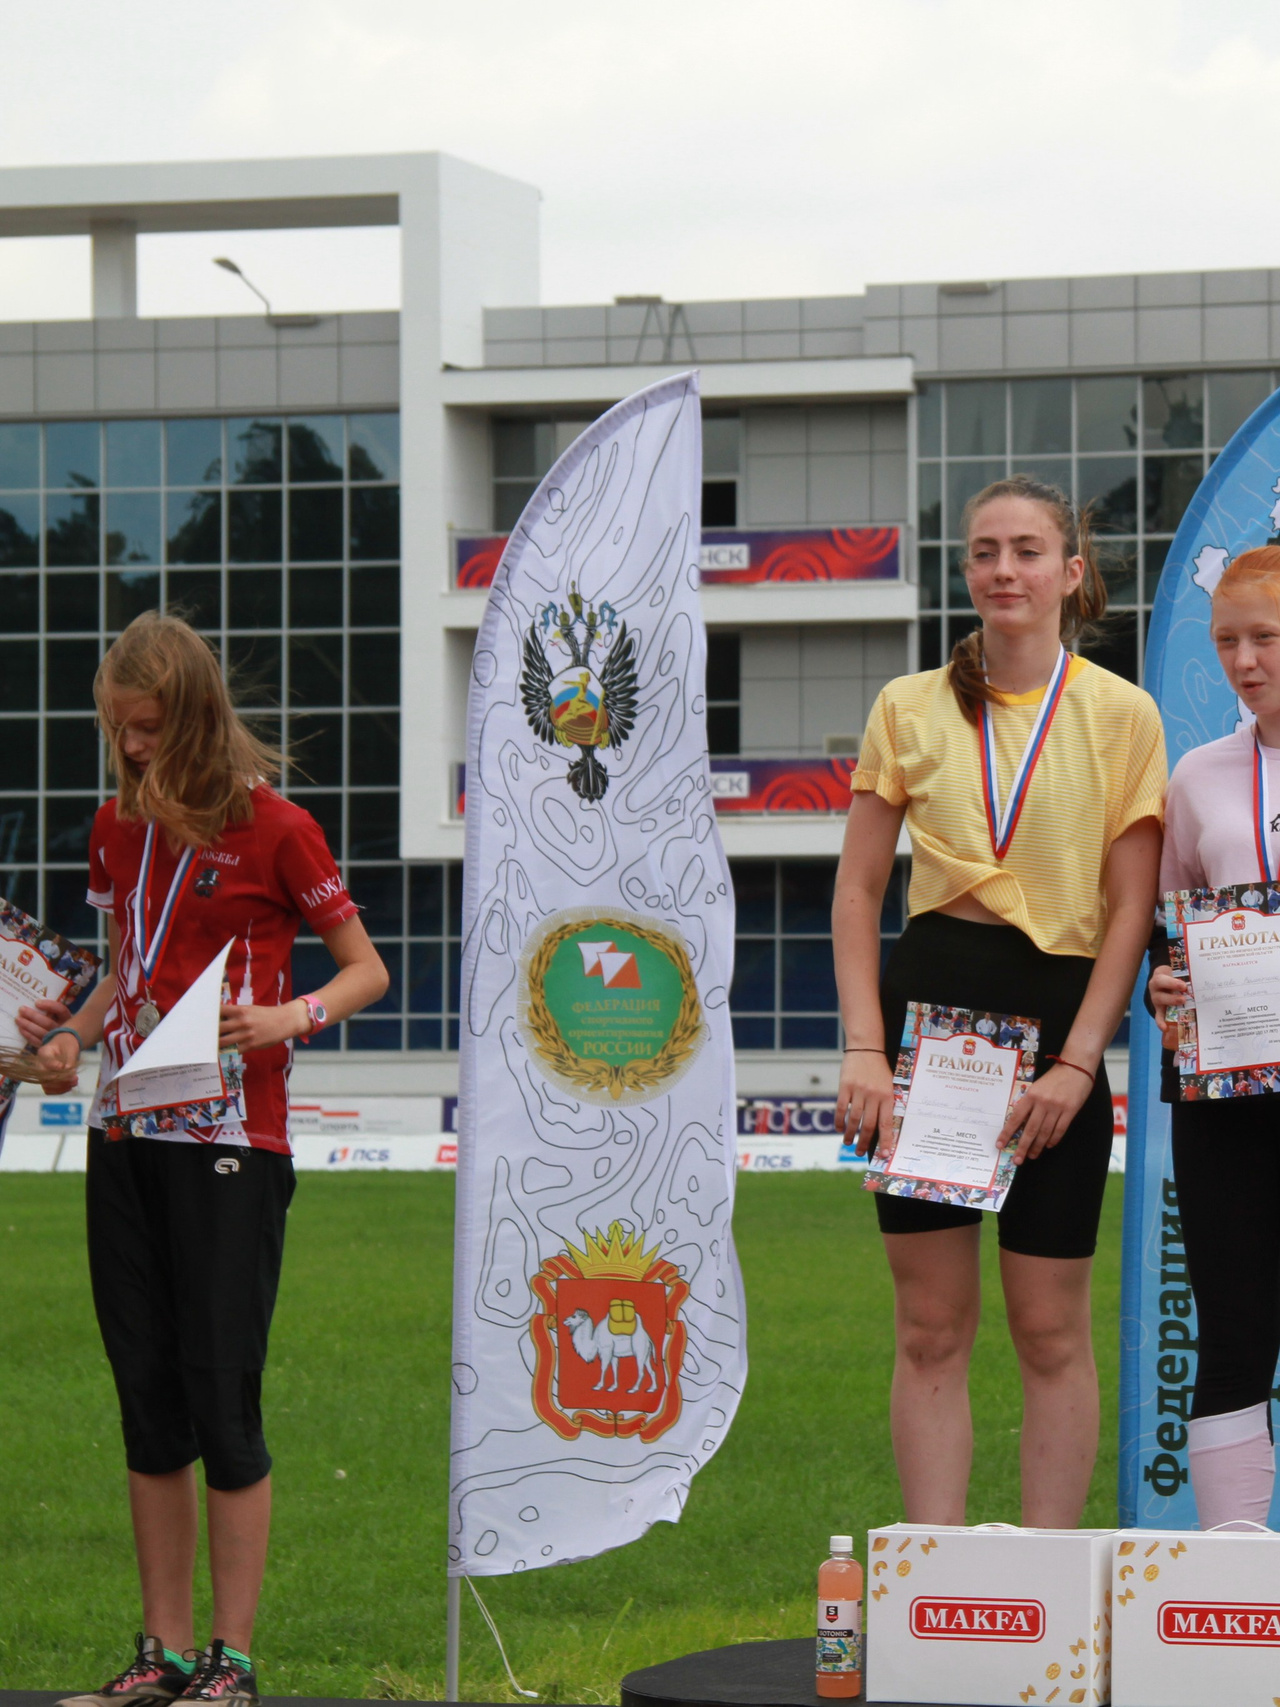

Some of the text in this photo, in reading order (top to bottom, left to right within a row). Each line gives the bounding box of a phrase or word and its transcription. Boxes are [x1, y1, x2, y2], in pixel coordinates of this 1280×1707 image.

[1198, 930, 1280, 951] ГРАМОТА
[0, 956, 49, 998] АМОТА
[571, 998, 661, 1014] ФЕДЕРАЦИЯ
[1246, 1005, 1269, 1013] МЕСТО
[582, 1041, 652, 1055] РОССИИ
[927, 1053, 1004, 1077] ГРАМОТА
[743, 1106, 863, 1132] РОСС
[956, 1131, 977, 1140] МЕСТО
[923, 1607, 1031, 1631] MAKFA
